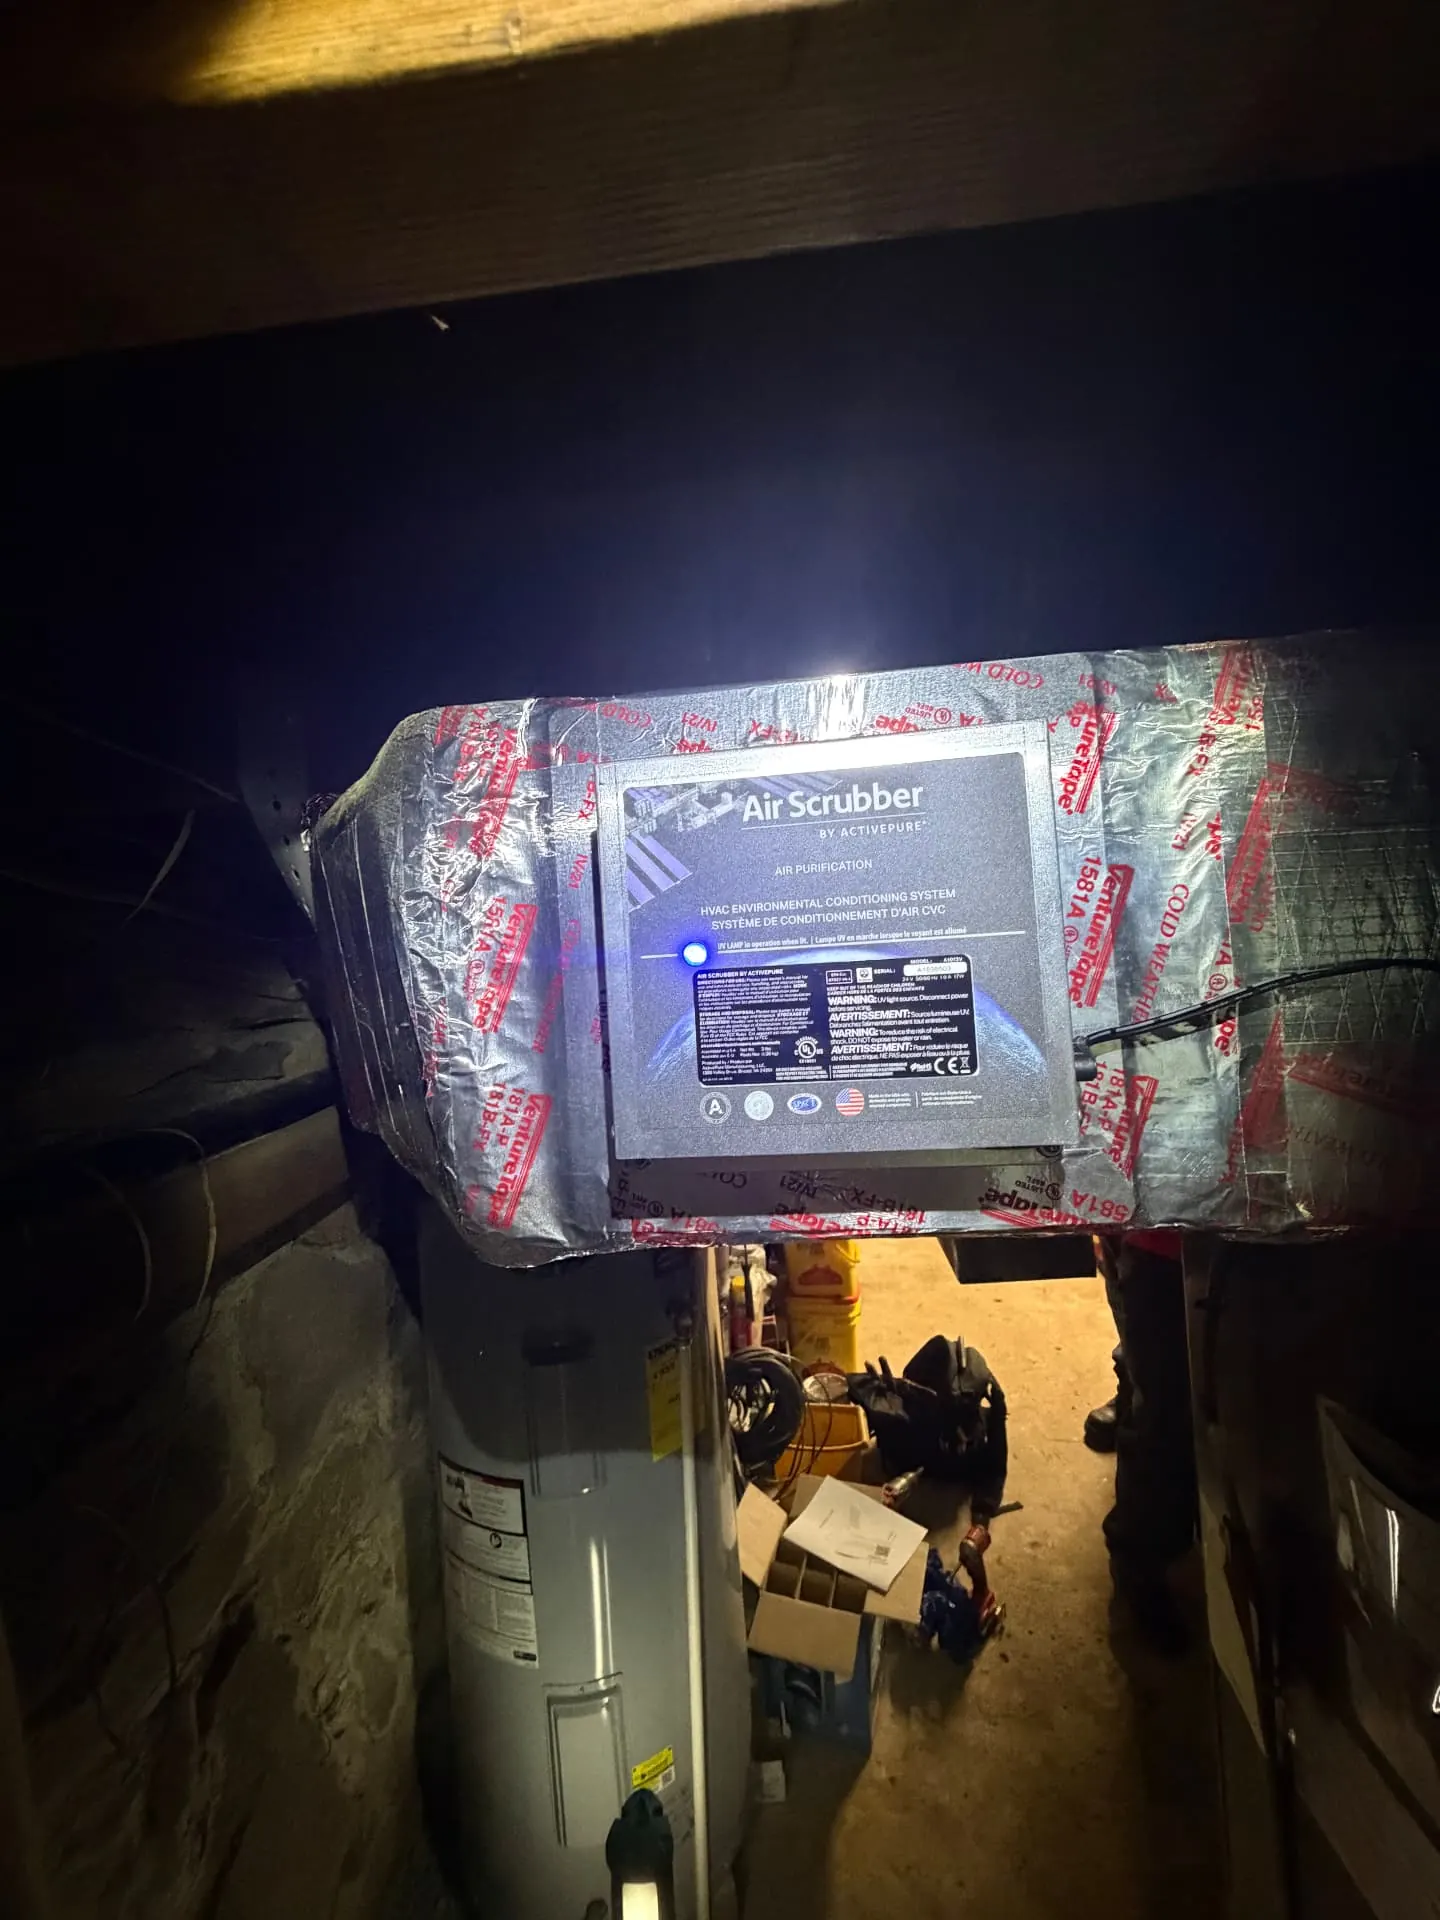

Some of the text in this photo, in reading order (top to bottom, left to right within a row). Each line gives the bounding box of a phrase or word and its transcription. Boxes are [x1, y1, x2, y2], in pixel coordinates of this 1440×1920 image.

[742, 782, 924, 822] Air Scrubber
[820, 828, 835, 839] BY
[775, 860, 872, 876] AIR PURIFICATION
[1066, 856, 1101, 919] 1581A
[700, 888, 956, 916] HVAC ENVIRONMENTAL CONDITIONING SYSTEM
[1160, 883, 1190, 938] COLD
[712, 905, 946, 930] SYSTÈME DE CONDITIONNEMENT D'AIR CVC
[828, 994, 877, 1006] WARNING:
[828, 1009, 910, 1022] AVERTISSEMENT:
[830, 1028, 879, 1038] WARNING:
[831, 1042, 912, 1055] AVERTISSEMENT:
[496, 1087, 526, 1148] 181A-P
[1072, 1189, 1129, 1223] 581A
